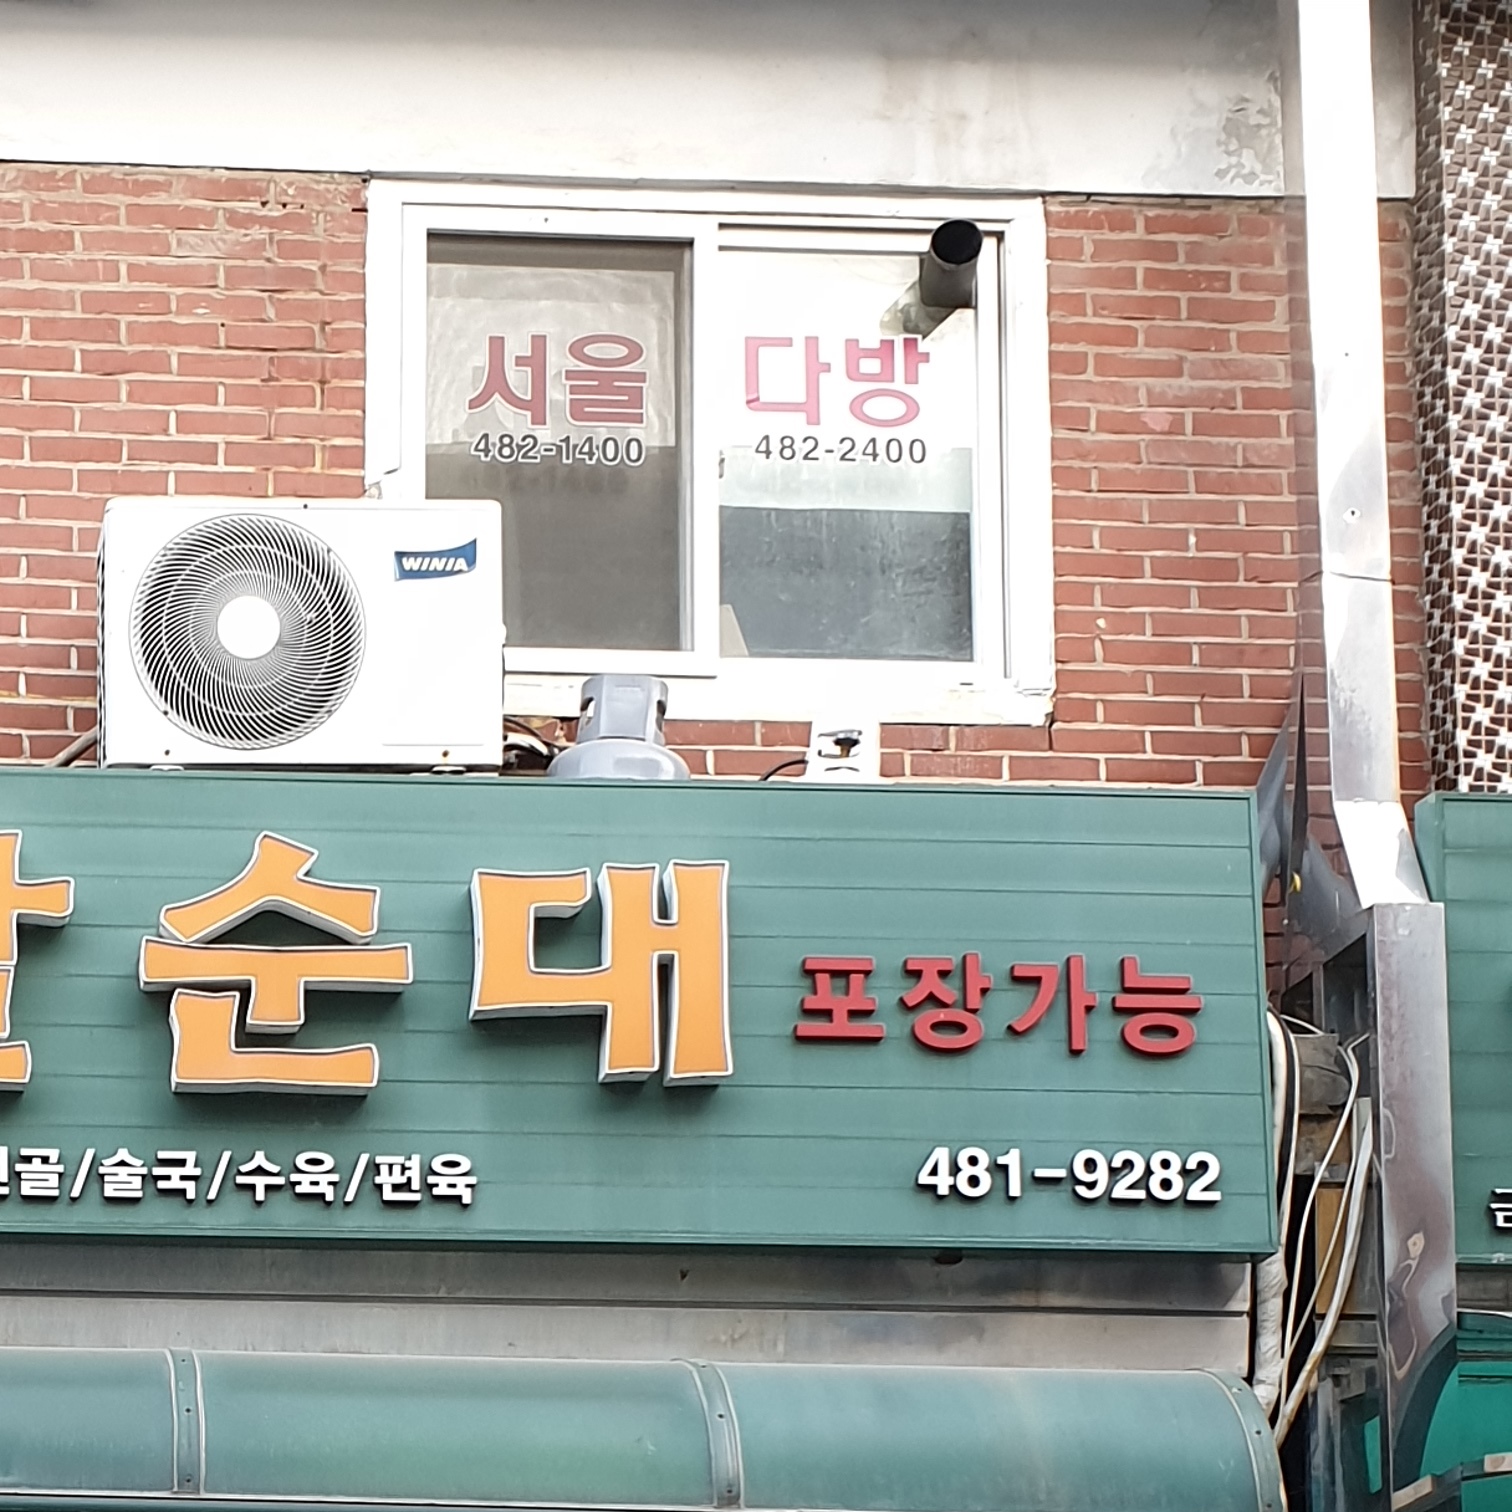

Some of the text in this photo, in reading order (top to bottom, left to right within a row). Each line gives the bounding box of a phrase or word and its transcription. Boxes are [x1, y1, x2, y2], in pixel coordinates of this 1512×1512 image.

[467, 332, 930, 428] 서울 다방
[469, 432, 647, 467] 482-1400
[754, 434, 928, 466] 482-2400
[401, 556, 469, 572] WINIA
[793, 952, 1203, 1056] 포장가능
[917, 1146, 1223, 1206] 481-9282
